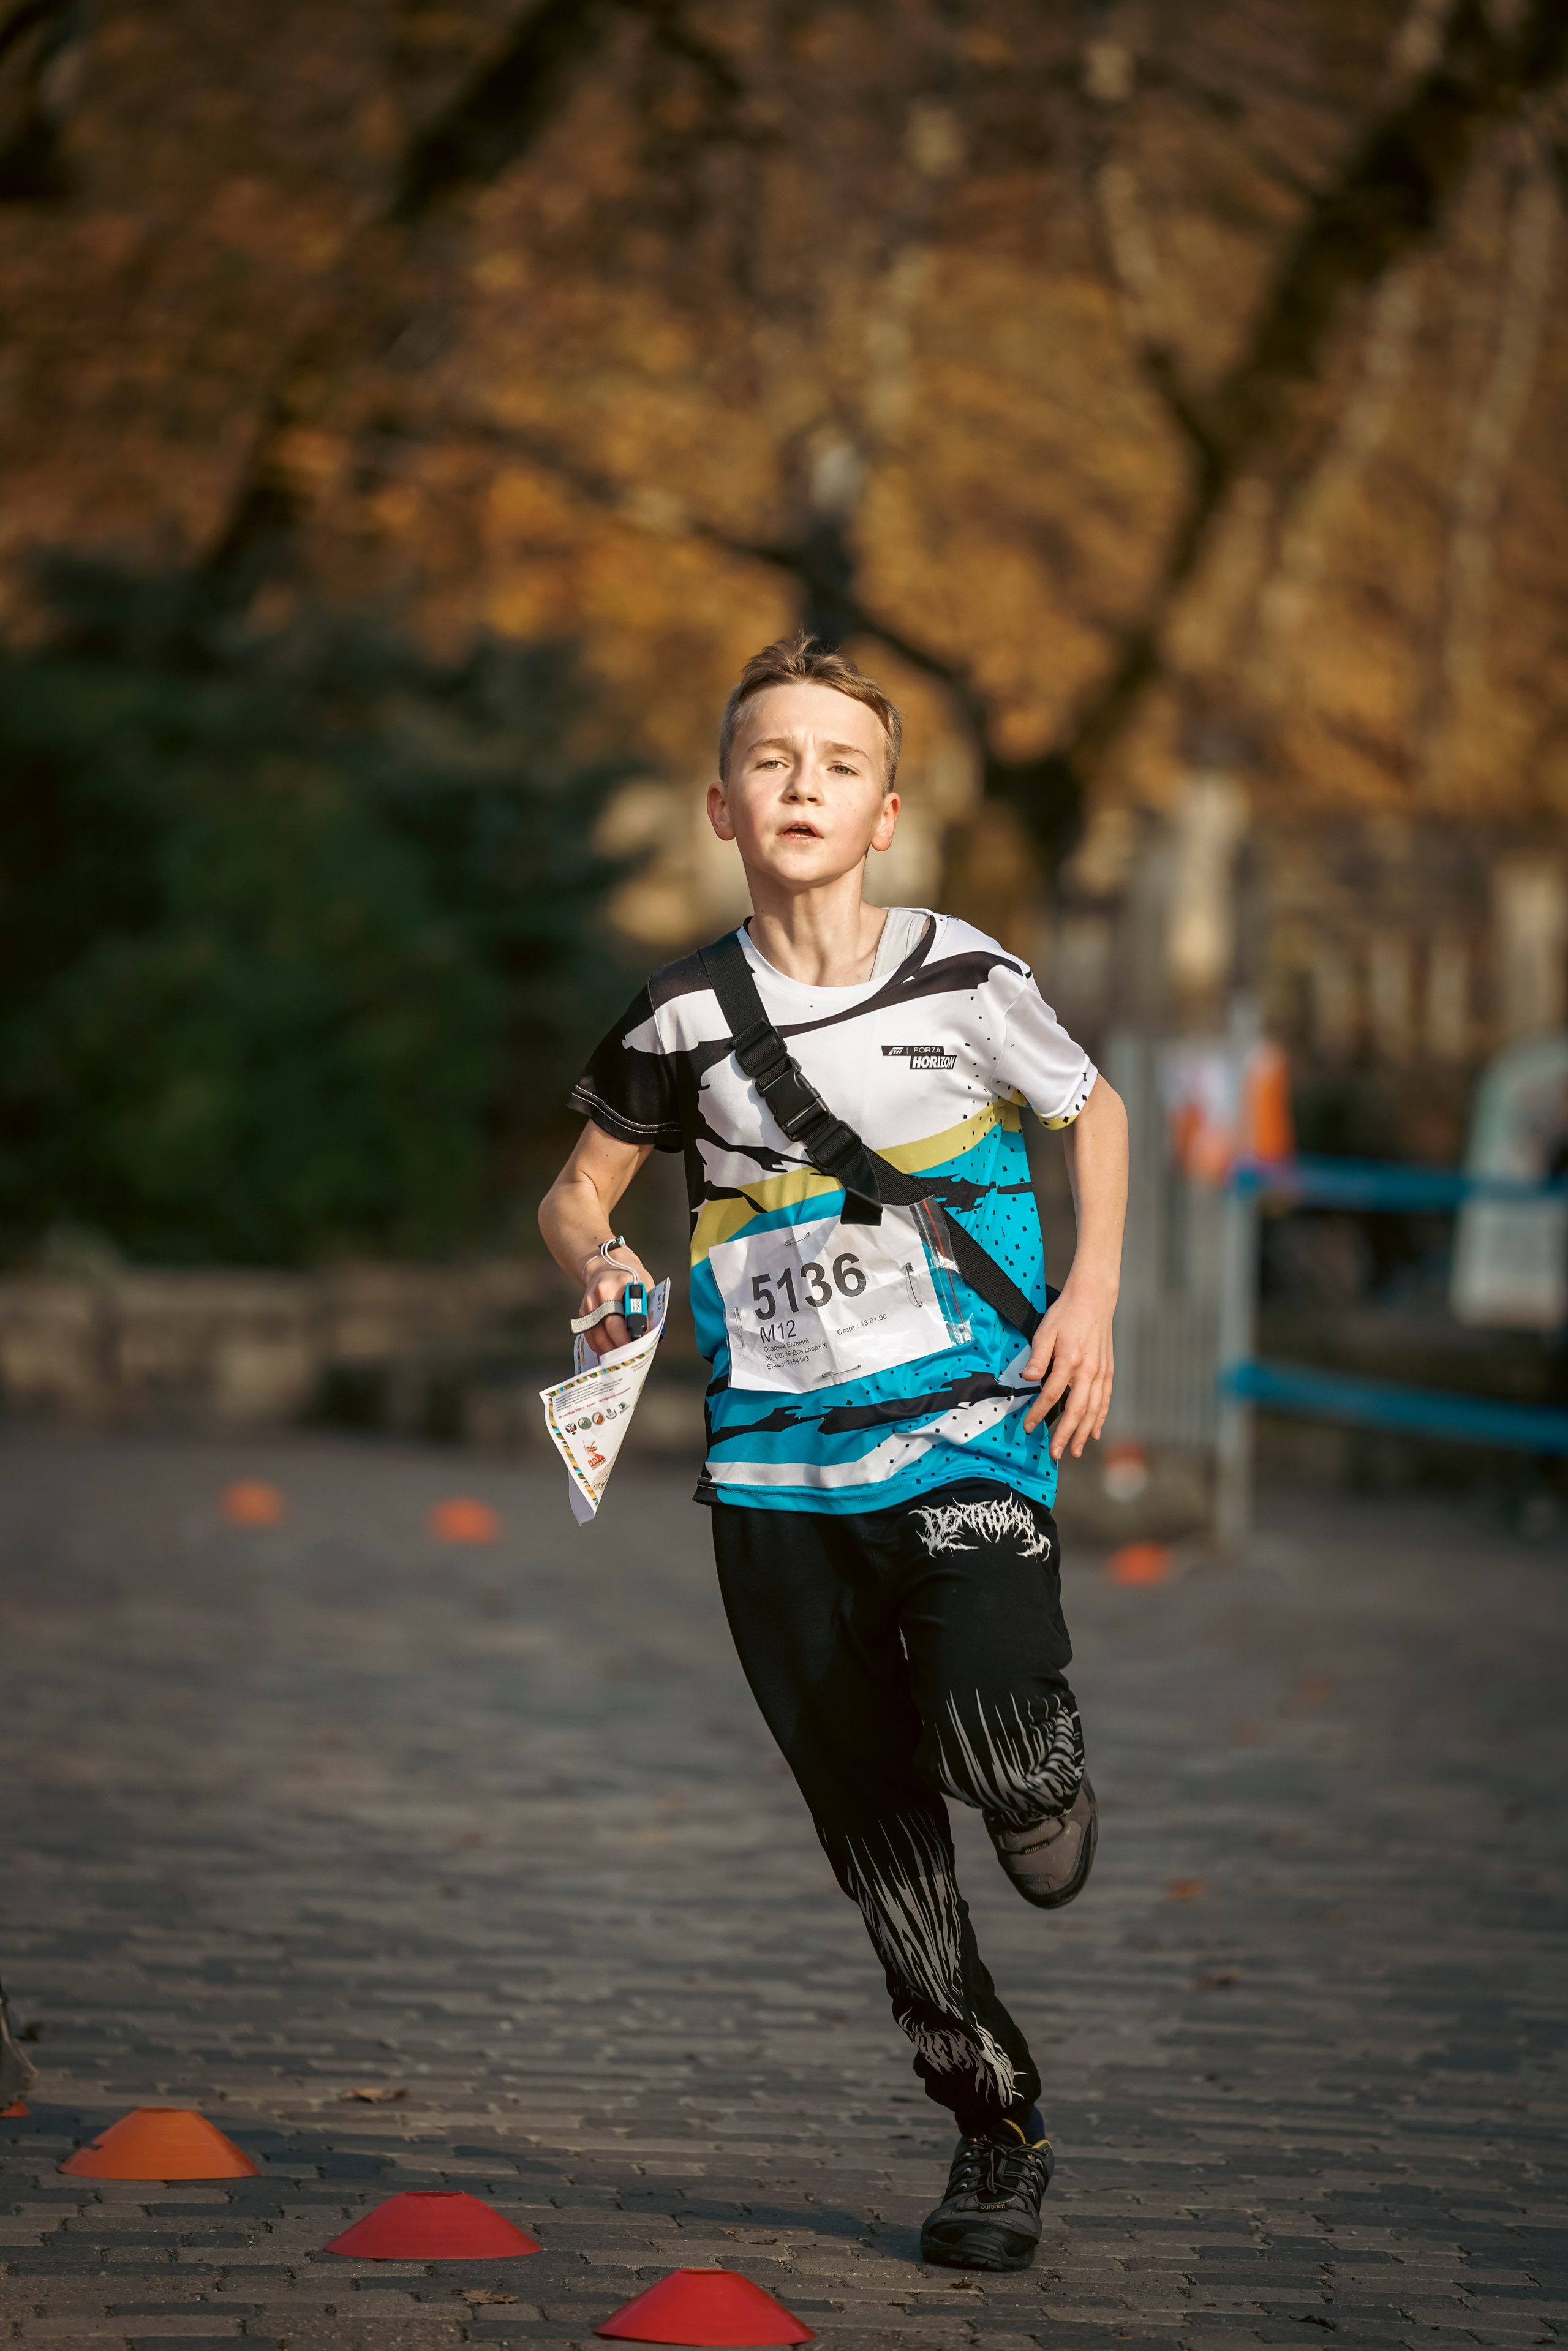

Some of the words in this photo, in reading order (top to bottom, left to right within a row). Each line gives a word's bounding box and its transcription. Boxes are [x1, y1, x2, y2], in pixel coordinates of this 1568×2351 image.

[912, 1055, 956, 1068] HORIZON
[752, 1253, 867, 1321] 5136
[837, 1325, 855, 1335] Старт
[861, 1313, 887, 1327] 13:01:00
[764, 1343, 786, 1353] Осадчий
[786, 1338, 810, 1348] Евгений
[805, 1345, 821, 1353] спорт
[787, 1356, 810, 1366] 2154143
